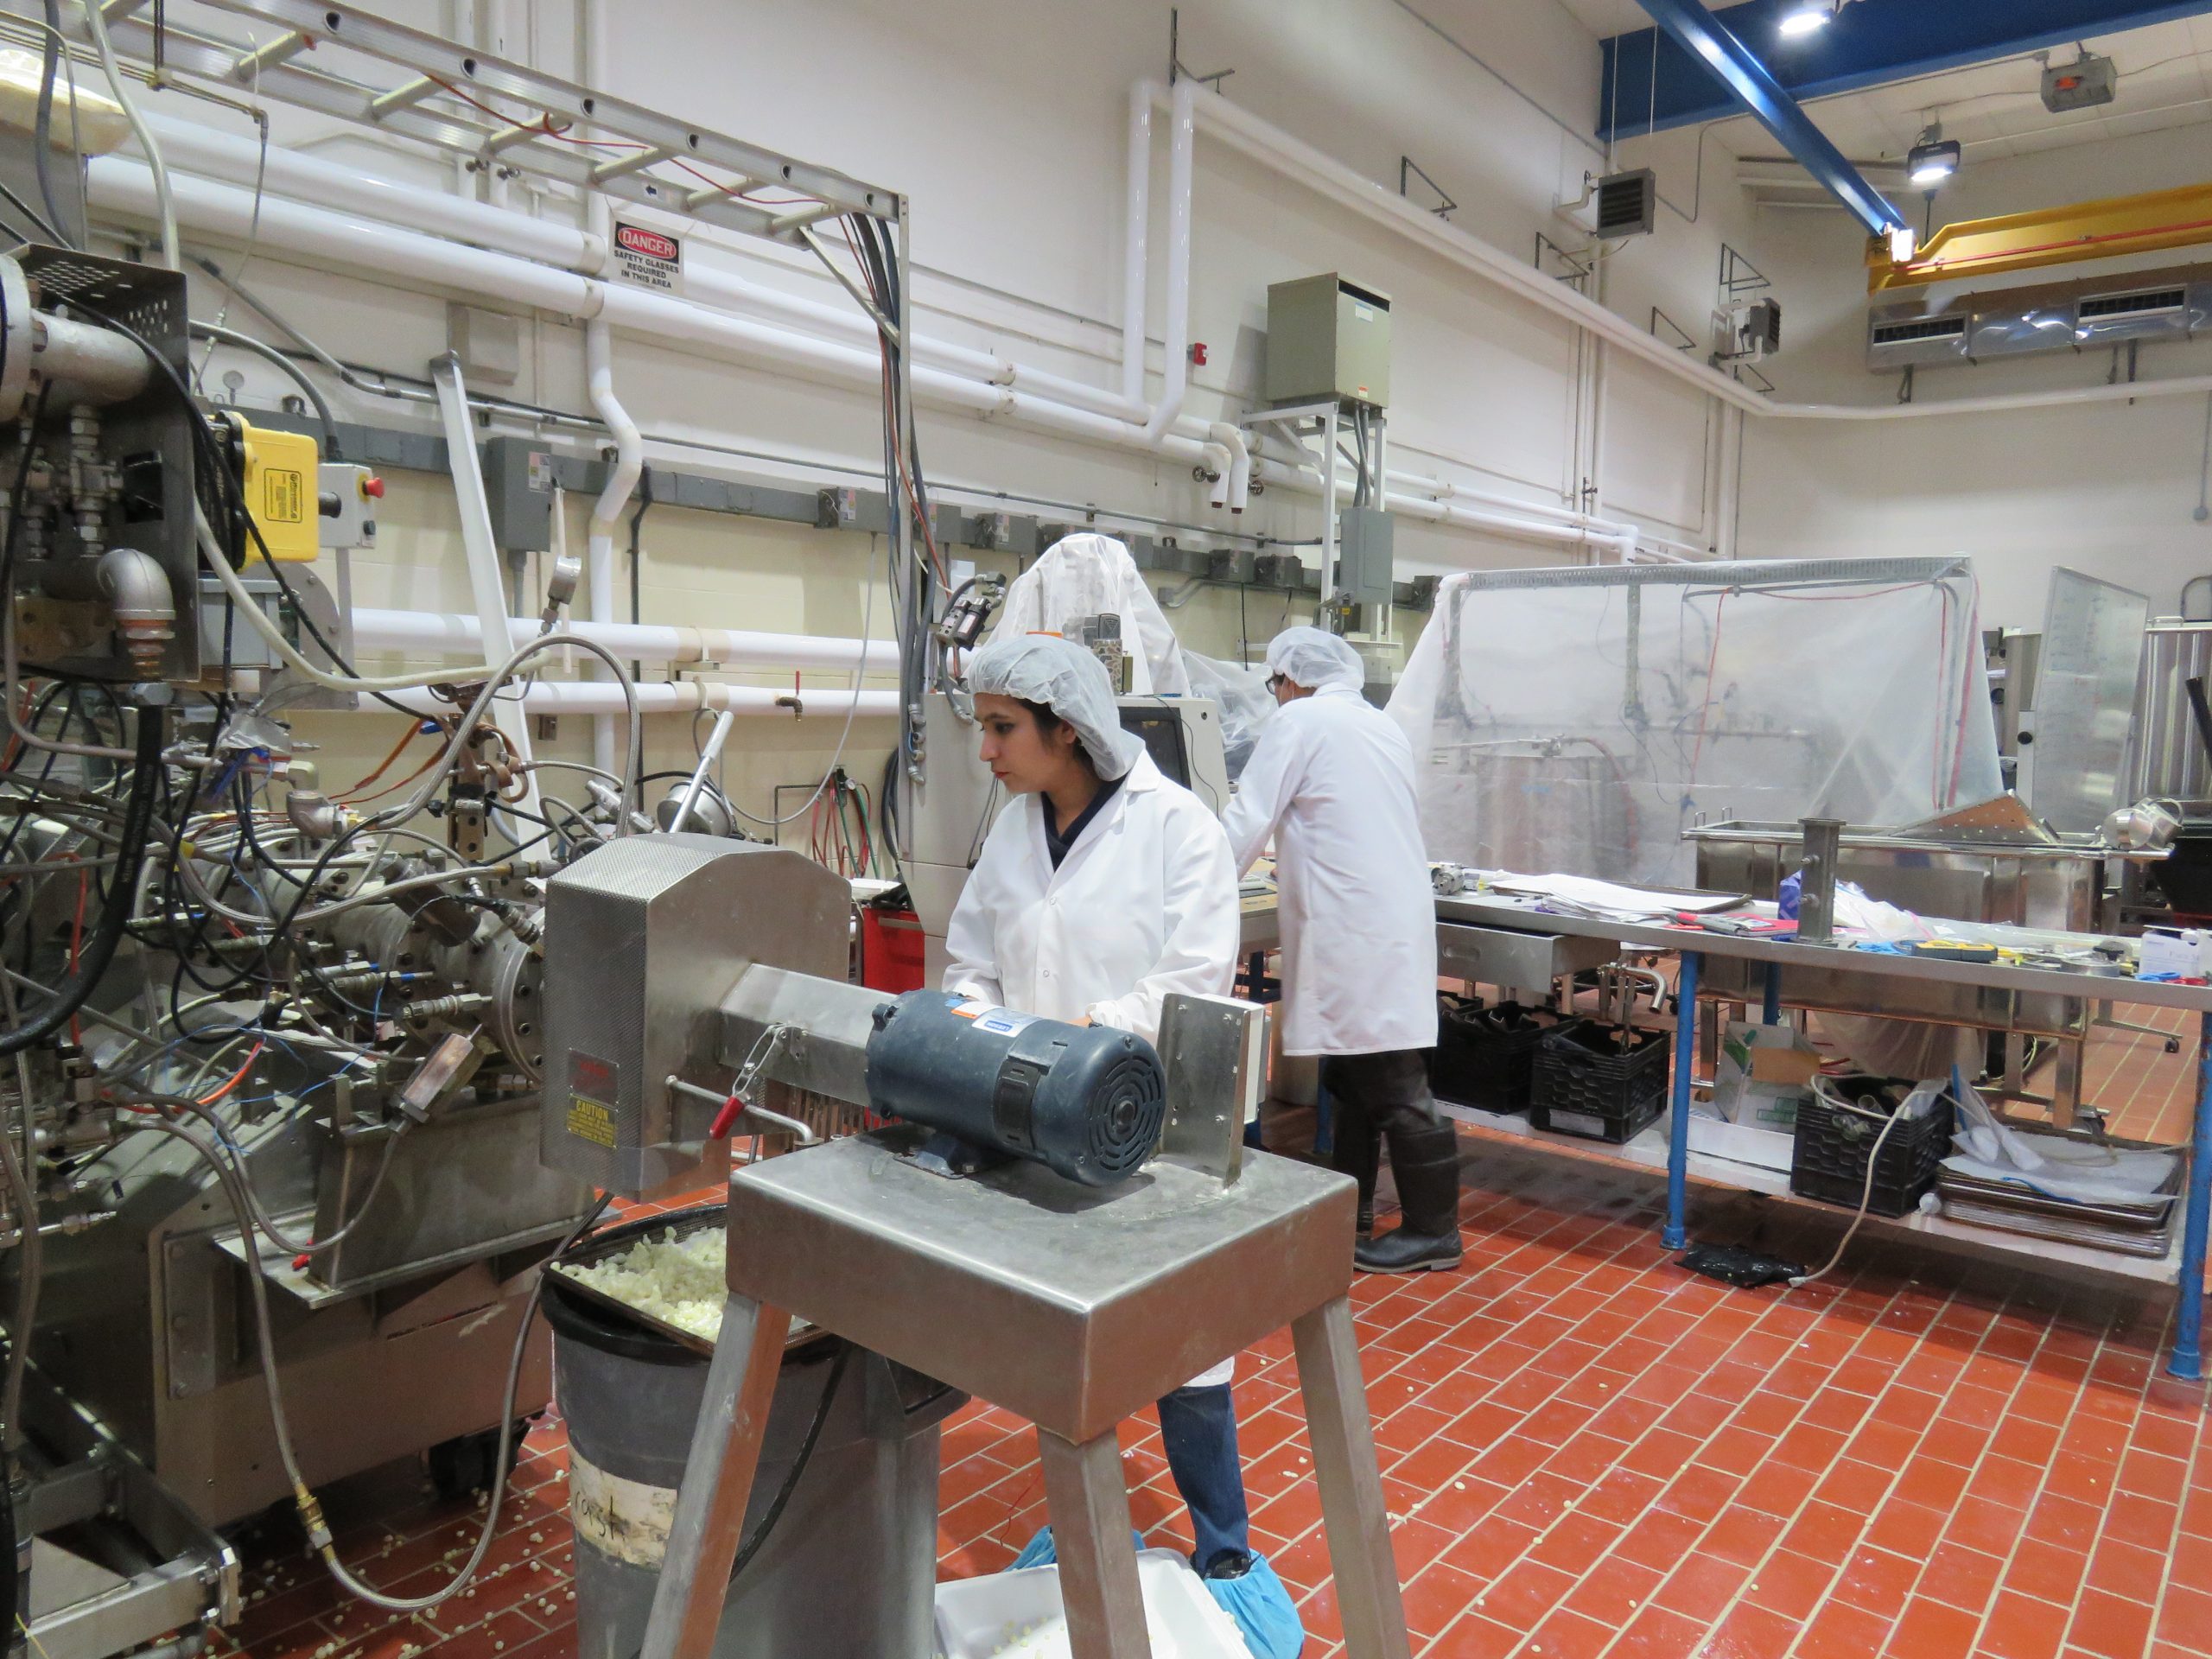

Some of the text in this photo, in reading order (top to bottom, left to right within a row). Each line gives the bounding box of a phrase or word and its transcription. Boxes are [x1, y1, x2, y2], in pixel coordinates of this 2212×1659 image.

[622, 230, 672, 256] DANGER
[614, 250, 679, 274] SAFETY GLASSES
[627, 262, 667, 278] REQUIRED
[632, 272, 650, 283] THIS
[652, 277, 672, 289] AREA
[575, 1100, 608, 1121] CAUTION
